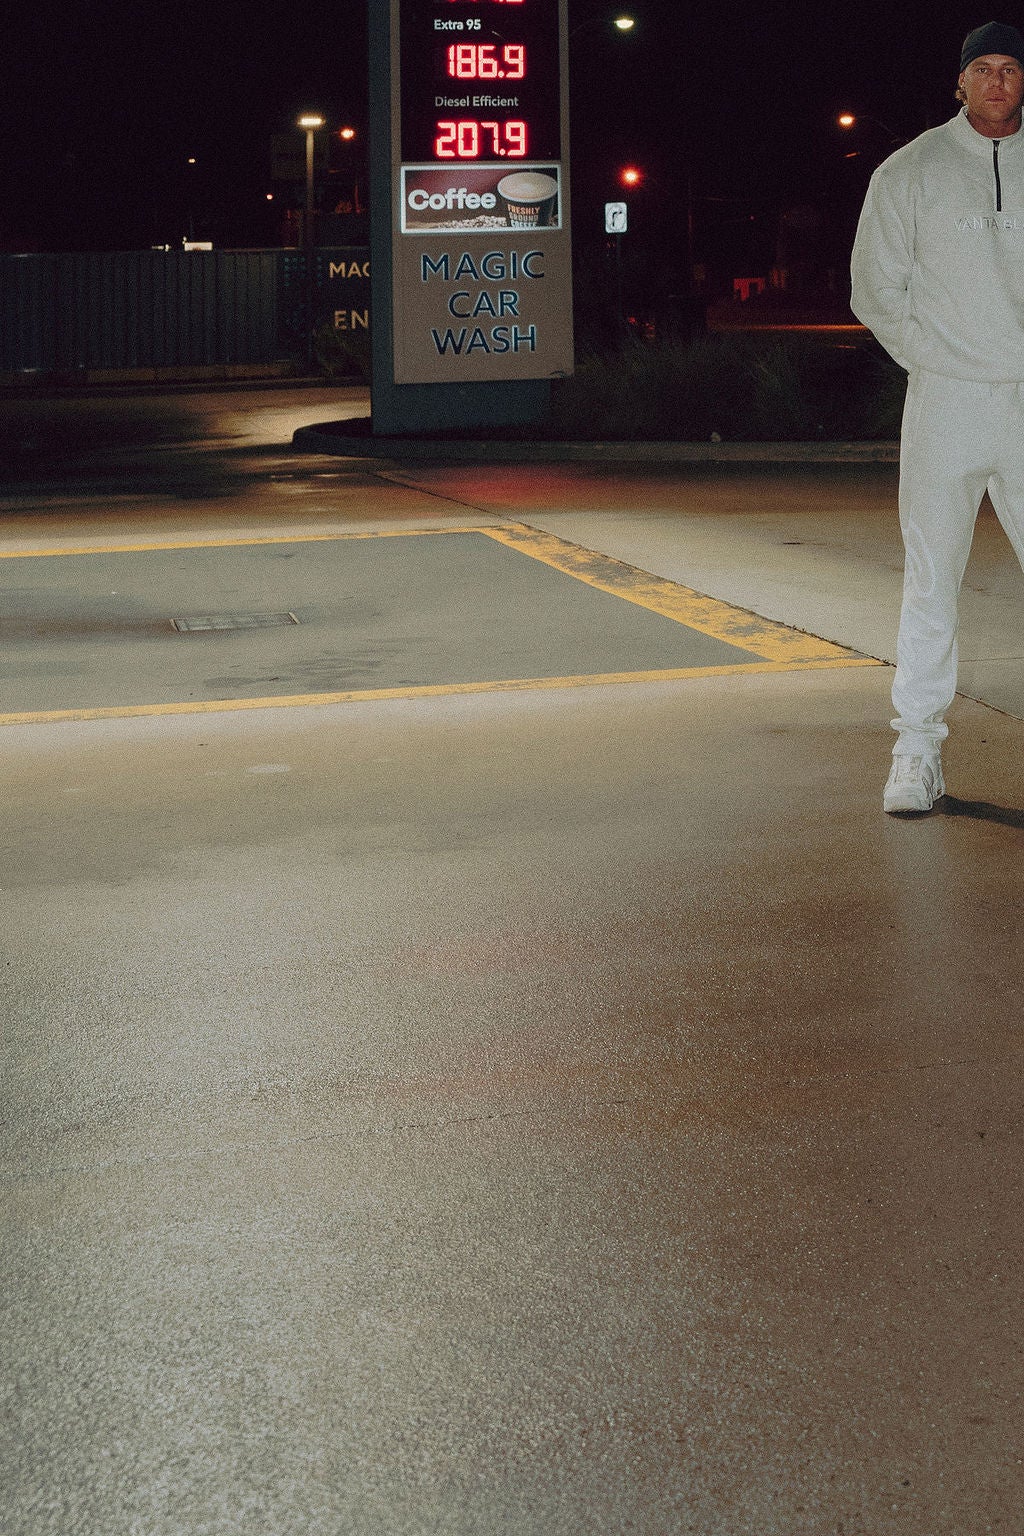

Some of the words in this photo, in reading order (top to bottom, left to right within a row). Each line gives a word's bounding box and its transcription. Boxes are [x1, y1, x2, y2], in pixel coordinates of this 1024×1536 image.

[434, 19, 464, 31] Extra
[466, 19, 482, 31] 95
[448, 44, 525, 78] 186.9
[435, 95, 470, 108] Diesel
[473, 95, 519, 108] Efficient
[435, 120, 528, 157] 207.9
[408, 188, 497, 211] Coffee
[421, 251, 546, 282] MAGIC
[448, 290, 521, 319] CAR
[431, 325, 538, 356] WASH
